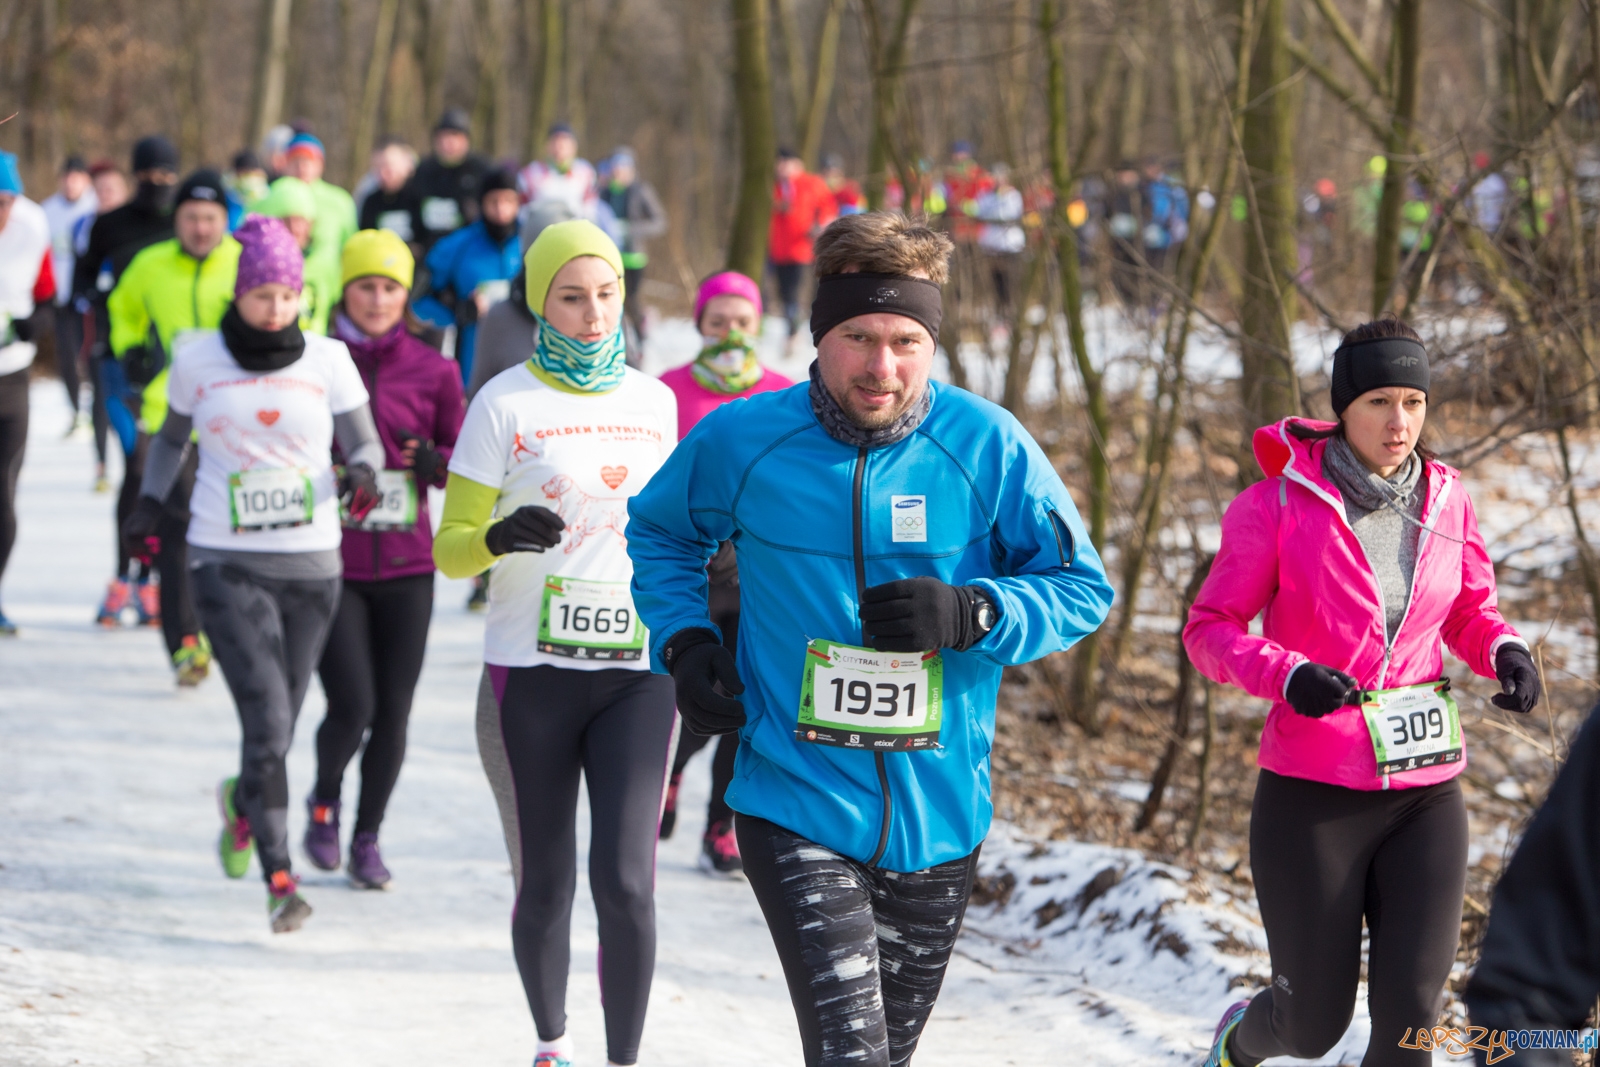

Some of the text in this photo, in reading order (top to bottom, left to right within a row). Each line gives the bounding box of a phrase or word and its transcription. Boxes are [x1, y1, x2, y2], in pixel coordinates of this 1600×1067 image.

[536, 426, 592, 439] GOLDEN
[240, 488, 304, 514] 1004
[559, 603, 630, 633] 1669
[830, 677, 916, 717] 1931
[930, 688, 939, 720] Poznań
[1387, 708, 1443, 745] 309
[1407, 744, 1436, 755] MARZENA
